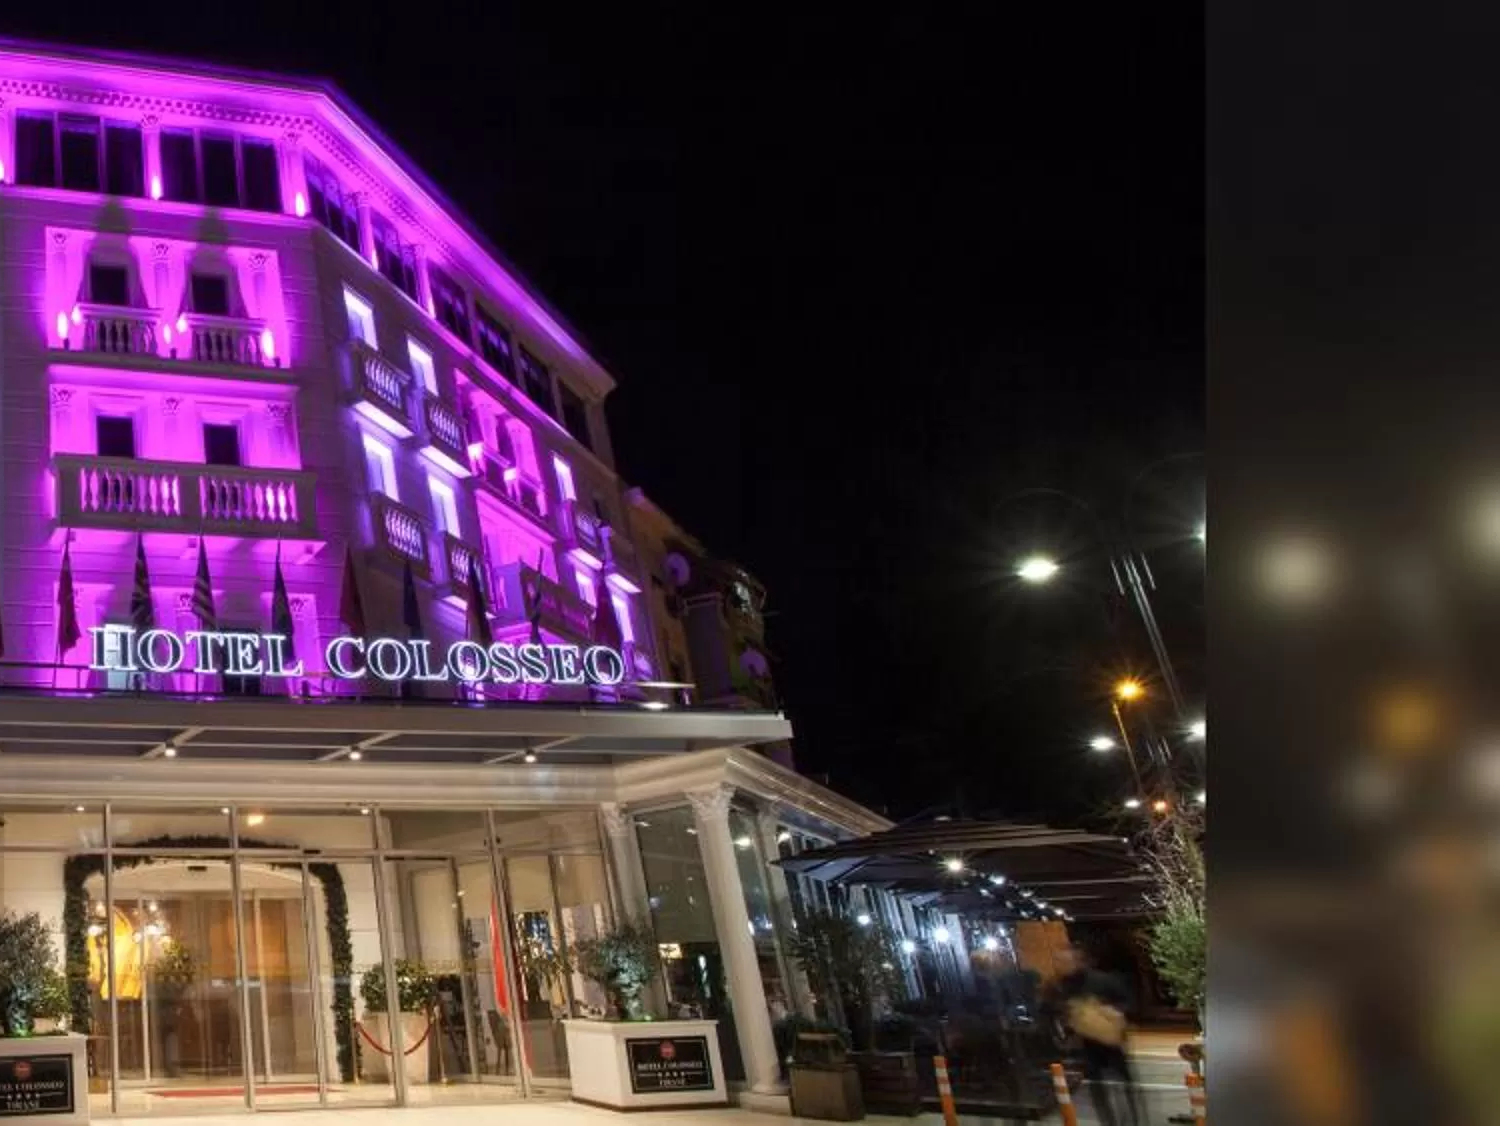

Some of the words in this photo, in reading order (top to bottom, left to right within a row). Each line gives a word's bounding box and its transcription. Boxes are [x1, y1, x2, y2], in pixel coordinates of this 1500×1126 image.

[89, 625, 304, 676] HOTEL
[325, 637, 624, 685] COLOSSEO
[637, 1062, 661, 1071] HOTEL
[15, 1080, 65, 1091] COLOSSEO
